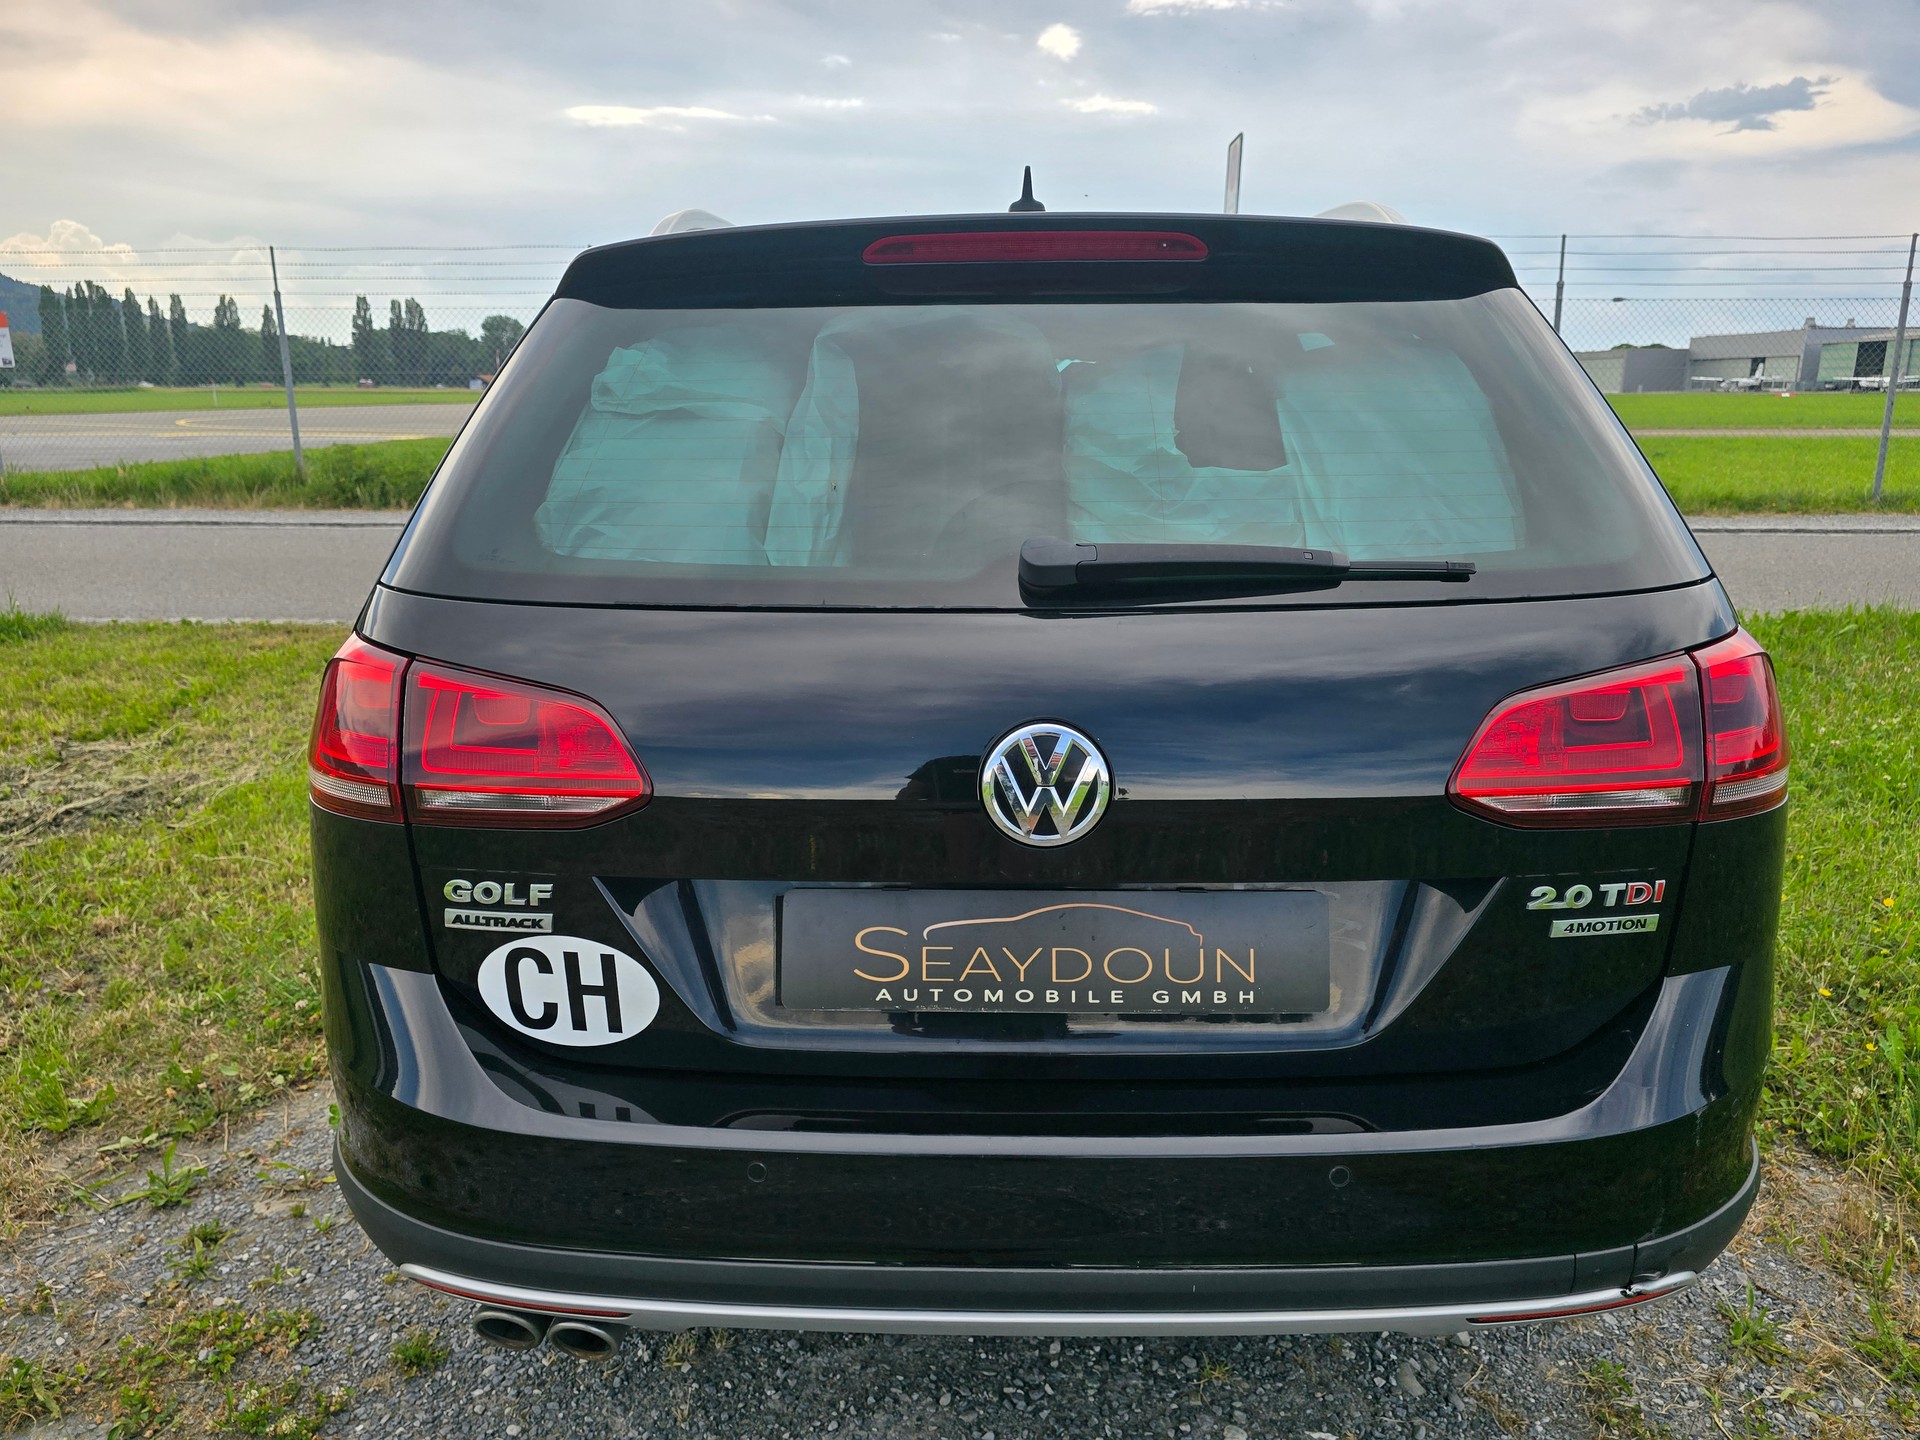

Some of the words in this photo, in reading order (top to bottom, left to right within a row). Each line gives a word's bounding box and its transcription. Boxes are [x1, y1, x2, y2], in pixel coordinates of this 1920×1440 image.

[443, 879, 554, 907] GOLF
[1599, 879, 1666, 907] TDI
[451, 914, 544, 930] ALLTRACK
[1563, 918, 1648, 934] 4MOTION
[504, 947, 623, 1034] CH
[875, 988, 1124, 1004] AUTOMOBILE
[1152, 990, 1255, 1004] GMBH
